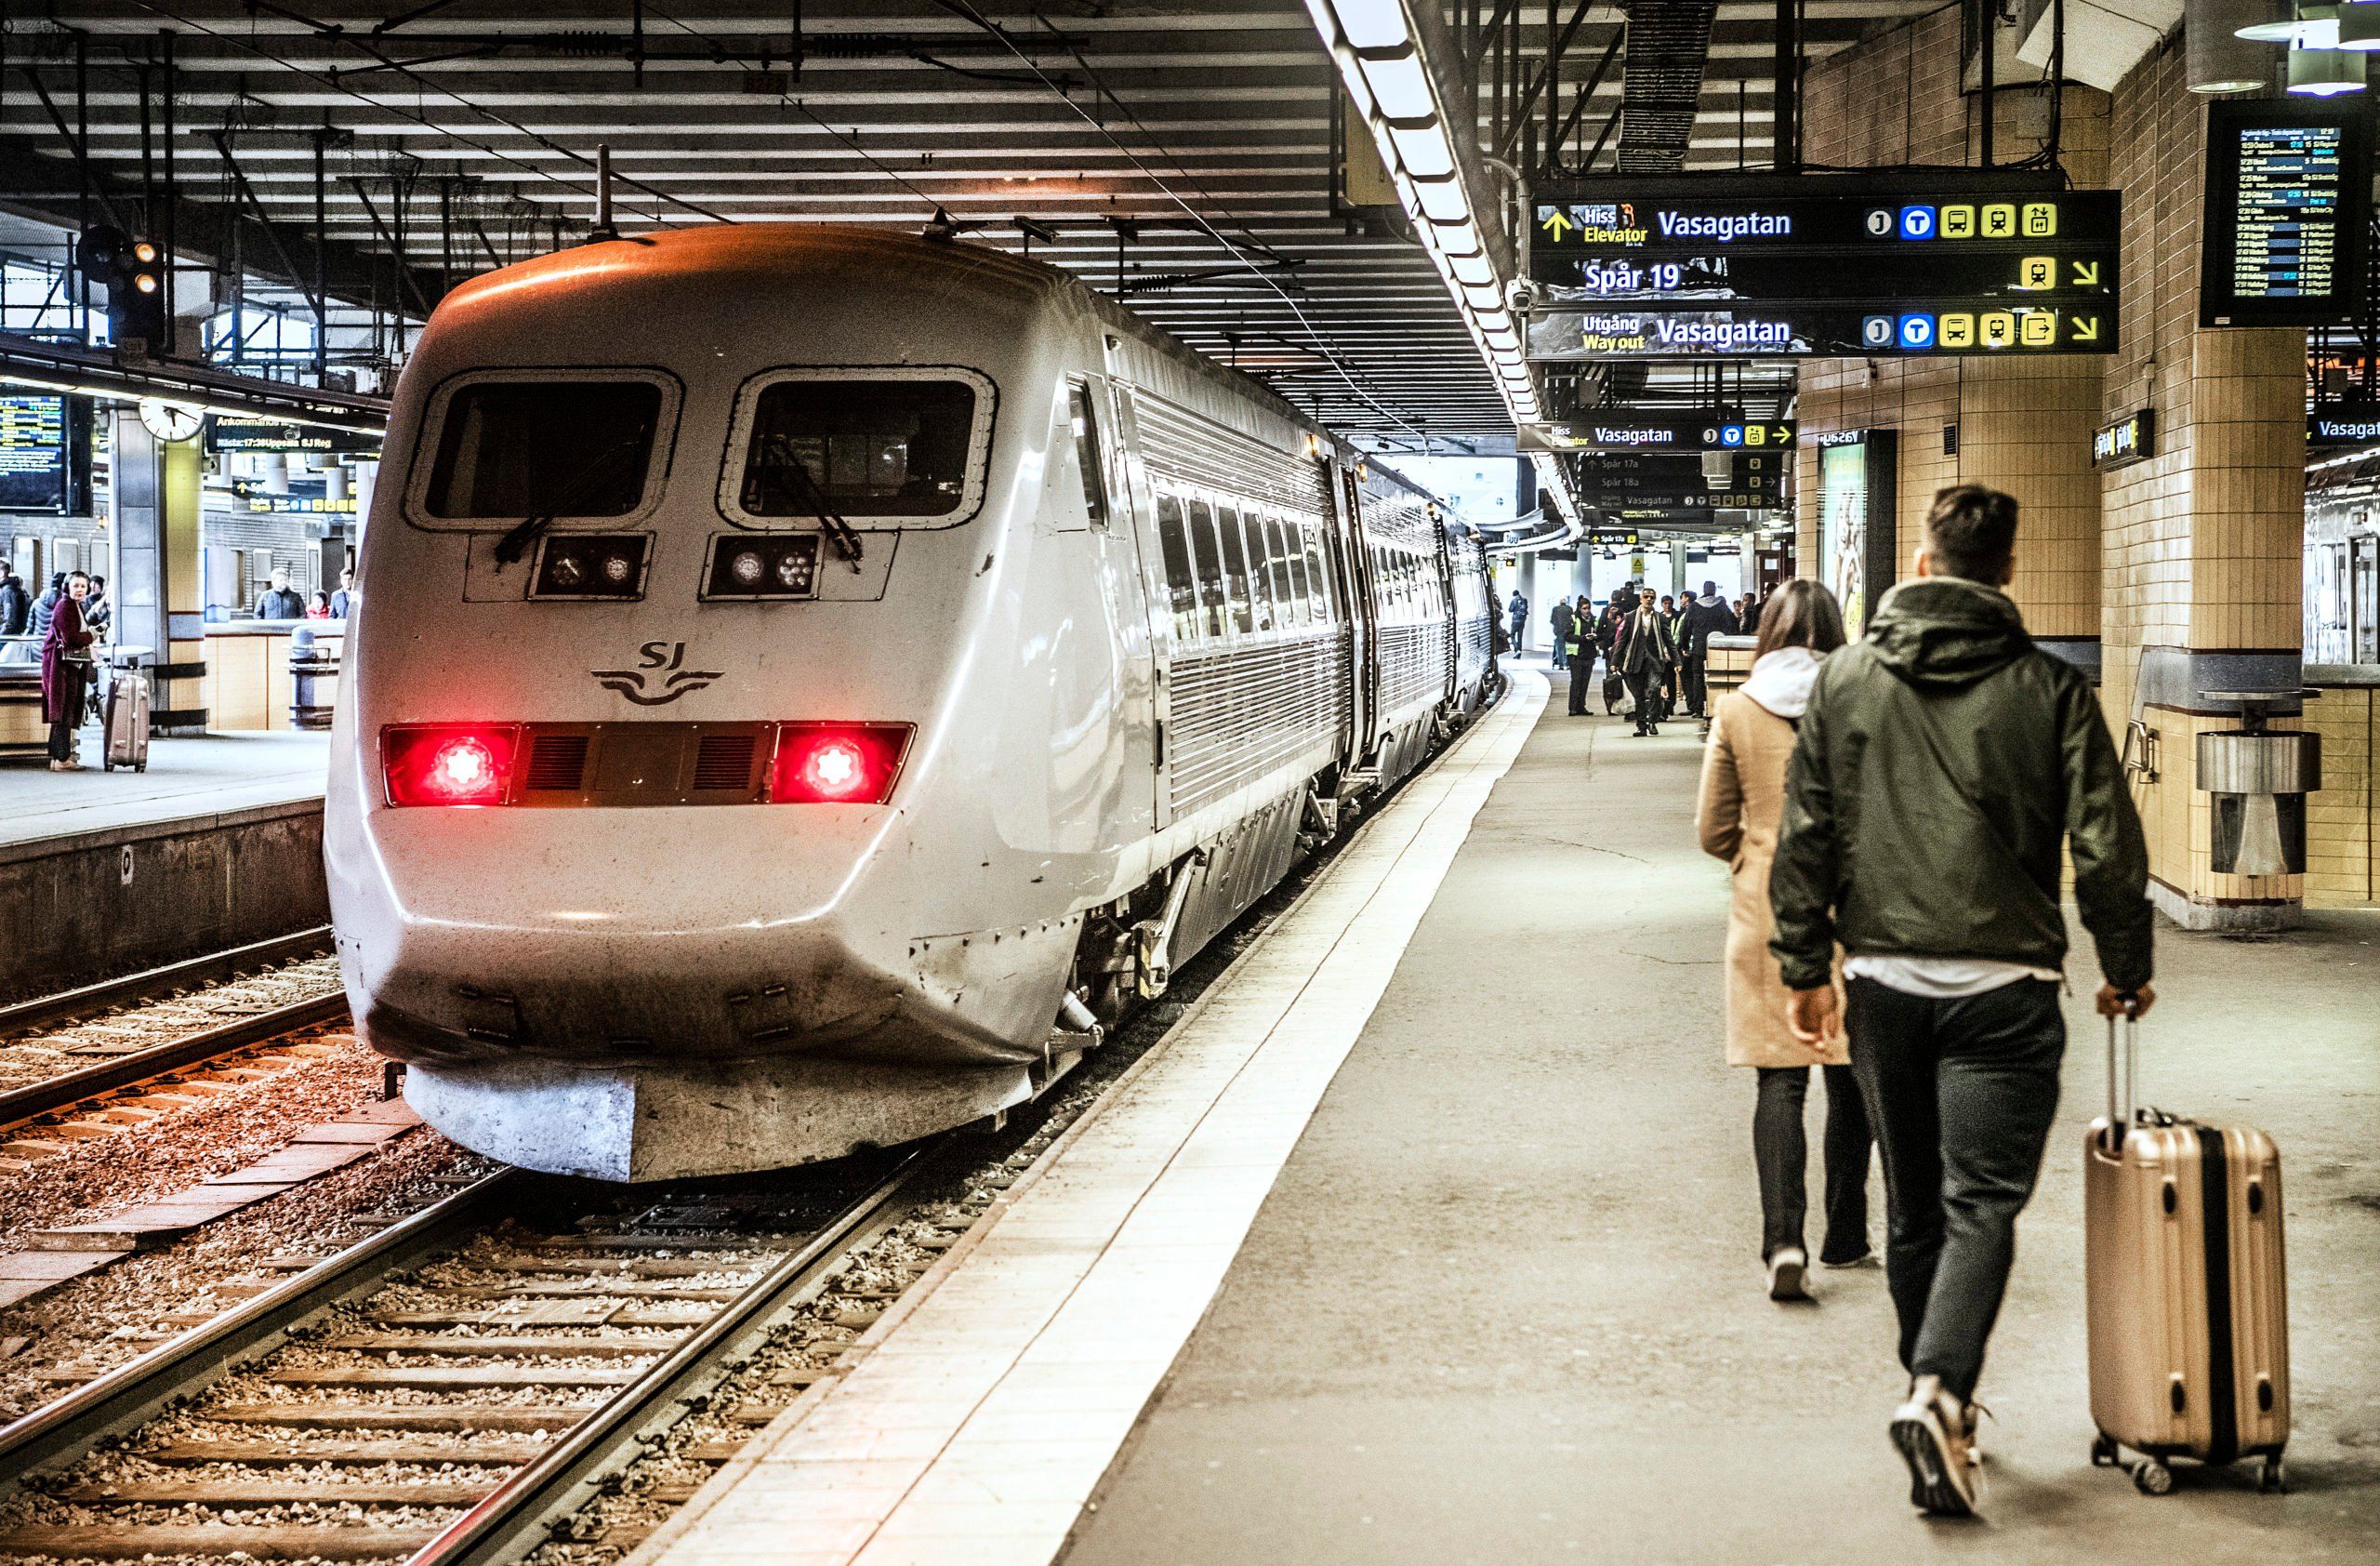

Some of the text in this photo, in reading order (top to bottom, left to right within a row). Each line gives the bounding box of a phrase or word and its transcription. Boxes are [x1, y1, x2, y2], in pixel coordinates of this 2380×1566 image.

[1584, 208, 1647, 243] Hiss Elevator
[1658, 211, 1792, 241] Vasagatan
[1586, 262, 1680, 294] Spår 19
[1583, 315, 1640, 335] Utgång
[1657, 319, 1791, 347] Vasagatan
[1583, 336, 1646, 352] Way out
[1551, 426, 1571, 435] Hiss
[1595, 428, 1673, 445] Vasagatan
[1602, 458, 1638, 470] Spår 17a
[1602, 477, 1639, 488] Spår 18a
[1627, 496, 1673, 506] Vasagatan
[1601, 535, 1615, 543] Spår
[638, 640, 686, 671] SJ
